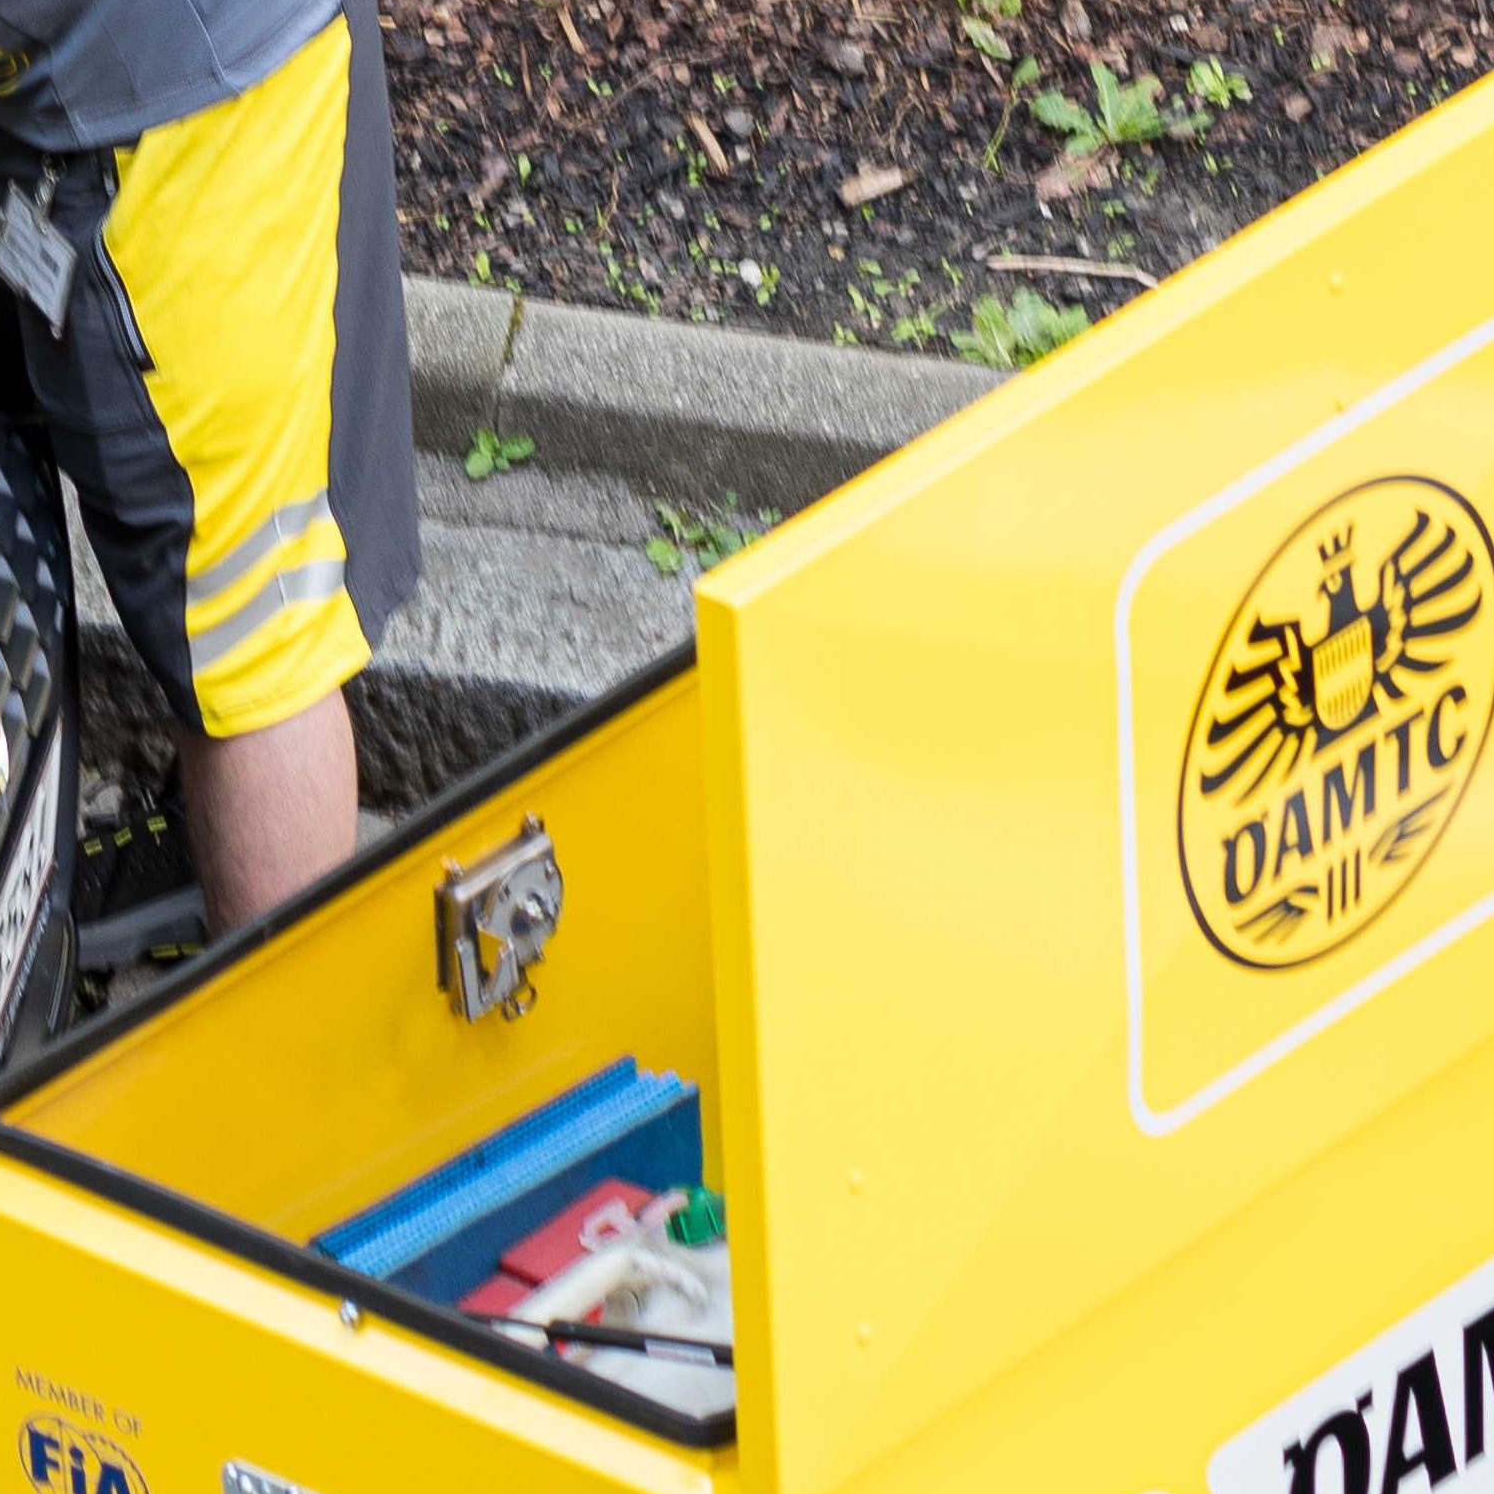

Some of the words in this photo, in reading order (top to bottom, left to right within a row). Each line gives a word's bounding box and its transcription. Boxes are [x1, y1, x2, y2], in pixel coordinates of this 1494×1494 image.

[1221, 684, 1469, 906] ÖAMTC
[15, 1365, 106, 1427] MEMBER
[112, 1405, 141, 1439] OF
